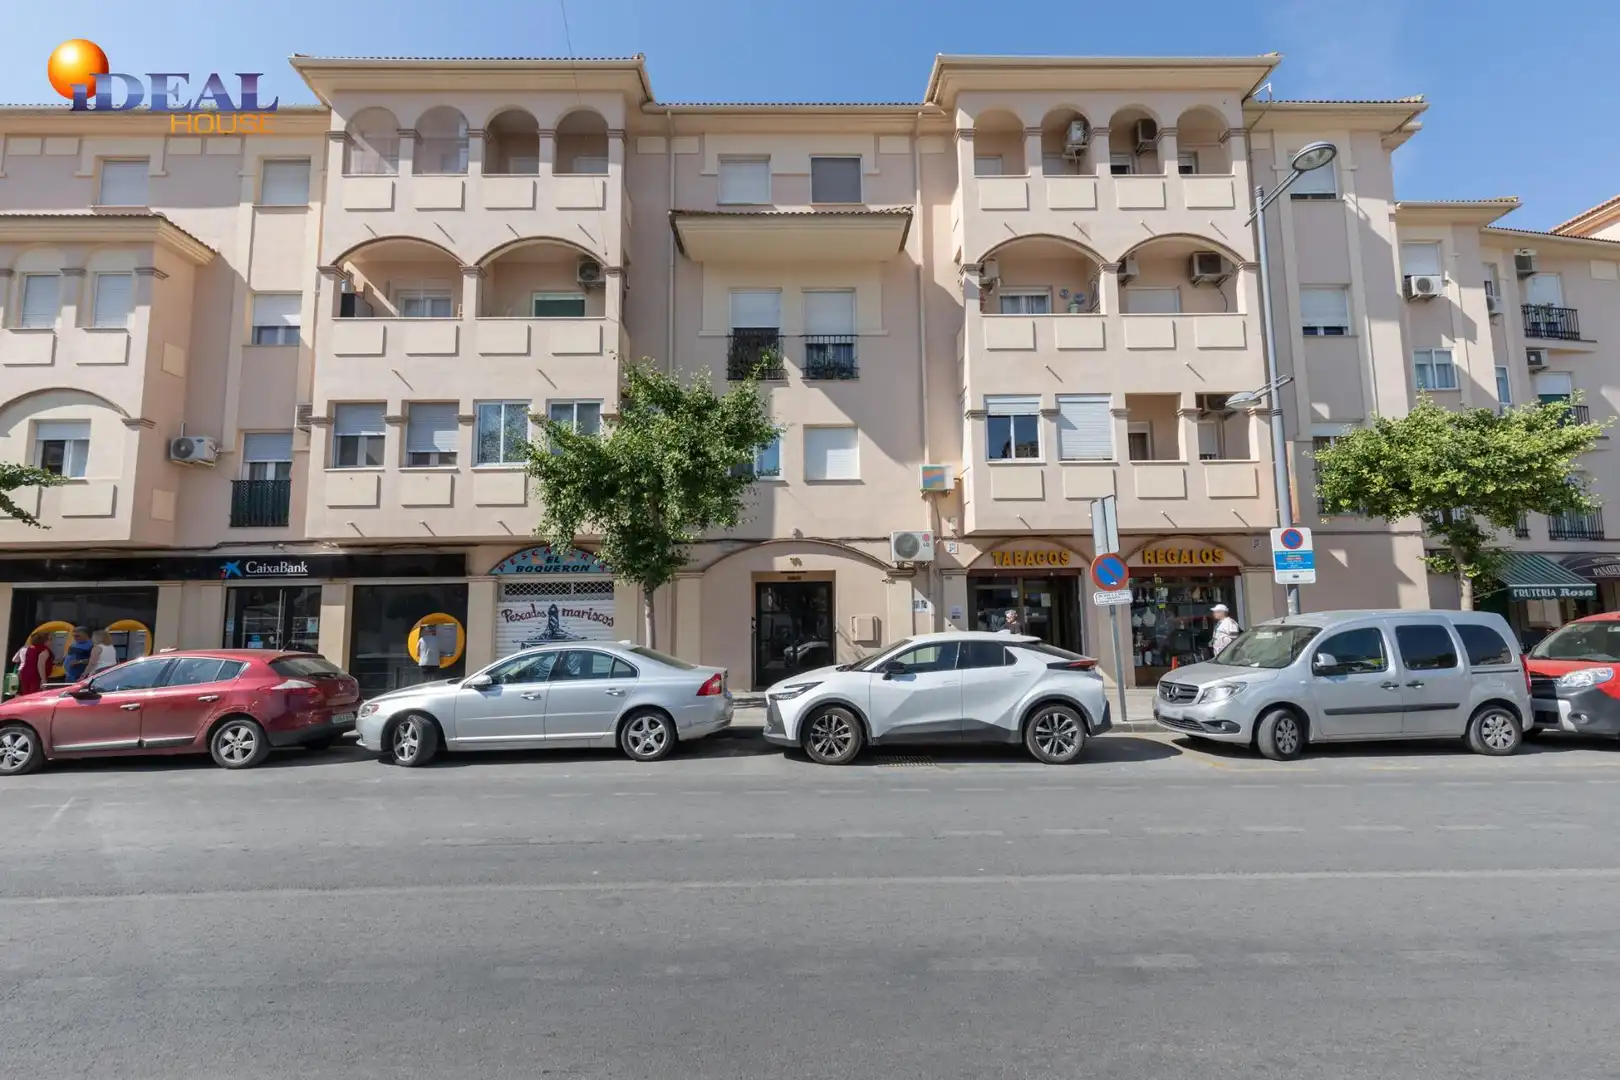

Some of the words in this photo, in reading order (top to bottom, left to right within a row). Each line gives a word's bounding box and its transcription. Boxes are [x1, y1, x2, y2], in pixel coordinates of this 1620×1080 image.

[498, 546, 606, 573] PESCAERIA
[991, 550, 1069, 566] TABACOS
[1143, 548, 1225, 564] REGALOS
[245, 560, 308, 574] CaixaBank
[516, 564, 590, 573] BOQUERON
[1513, 588, 1556, 597] FRUTERIA
[1560, 588, 1594, 597] Rosa
[501, 603, 547, 623] Pescados
[562, 607, 614, 627] mariscos
